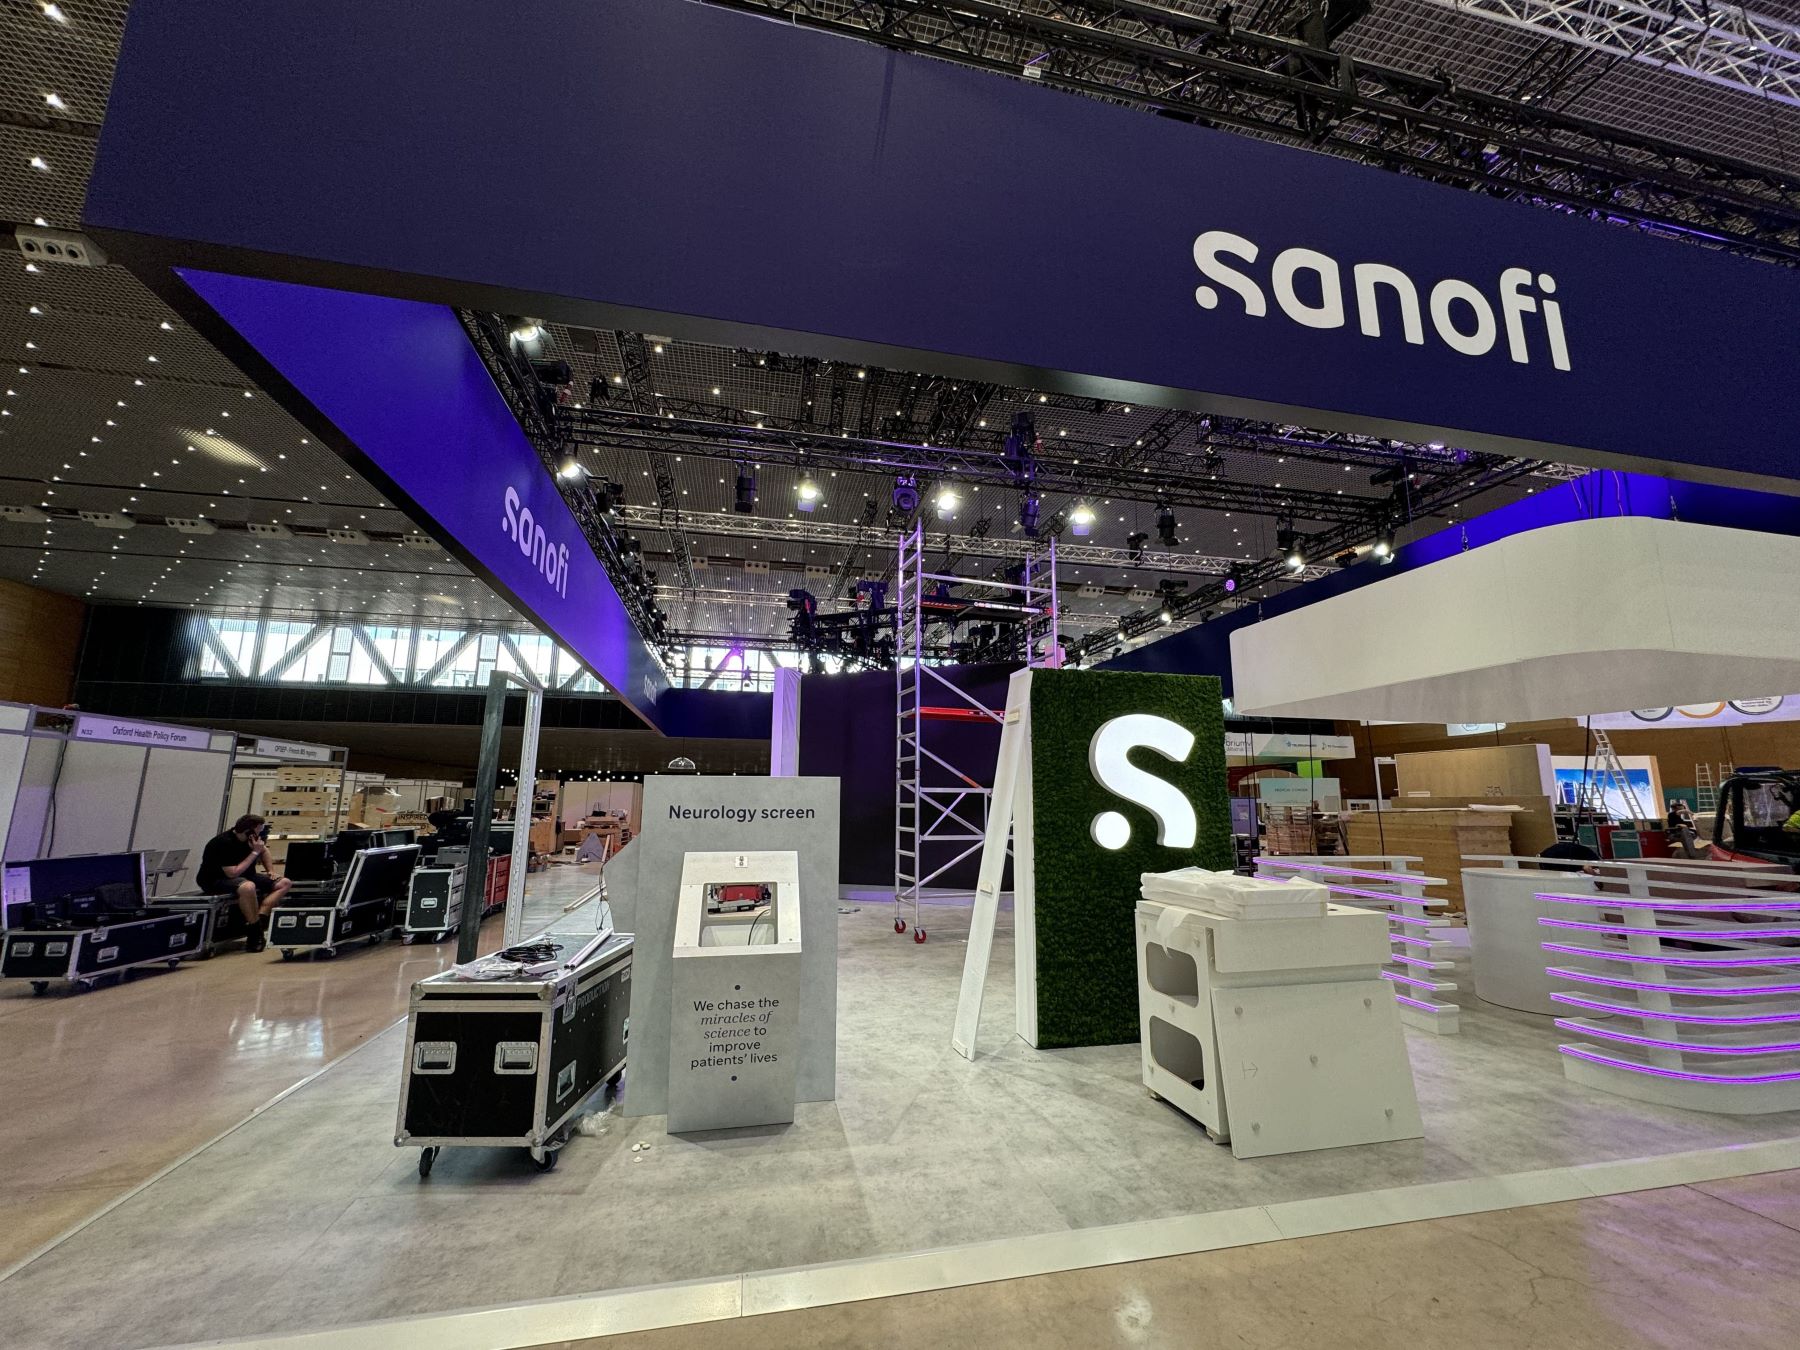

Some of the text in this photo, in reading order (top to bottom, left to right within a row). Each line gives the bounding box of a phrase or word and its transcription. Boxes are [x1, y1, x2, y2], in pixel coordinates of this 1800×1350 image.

[1193, 230, 1571, 371] sanofi
[501, 486, 570, 599] sanofi
[112, 725, 187, 742] Oxford Health Policy Forum
[668, 805, 815, 823] Neurology screen
[693, 997, 780, 1012] We chase the
[700, 1010, 774, 1026] miracles of
[703, 1026, 767, 1040] science to
[709, 1041, 761, 1054] improve
[750, 1053, 778, 1064] lives
